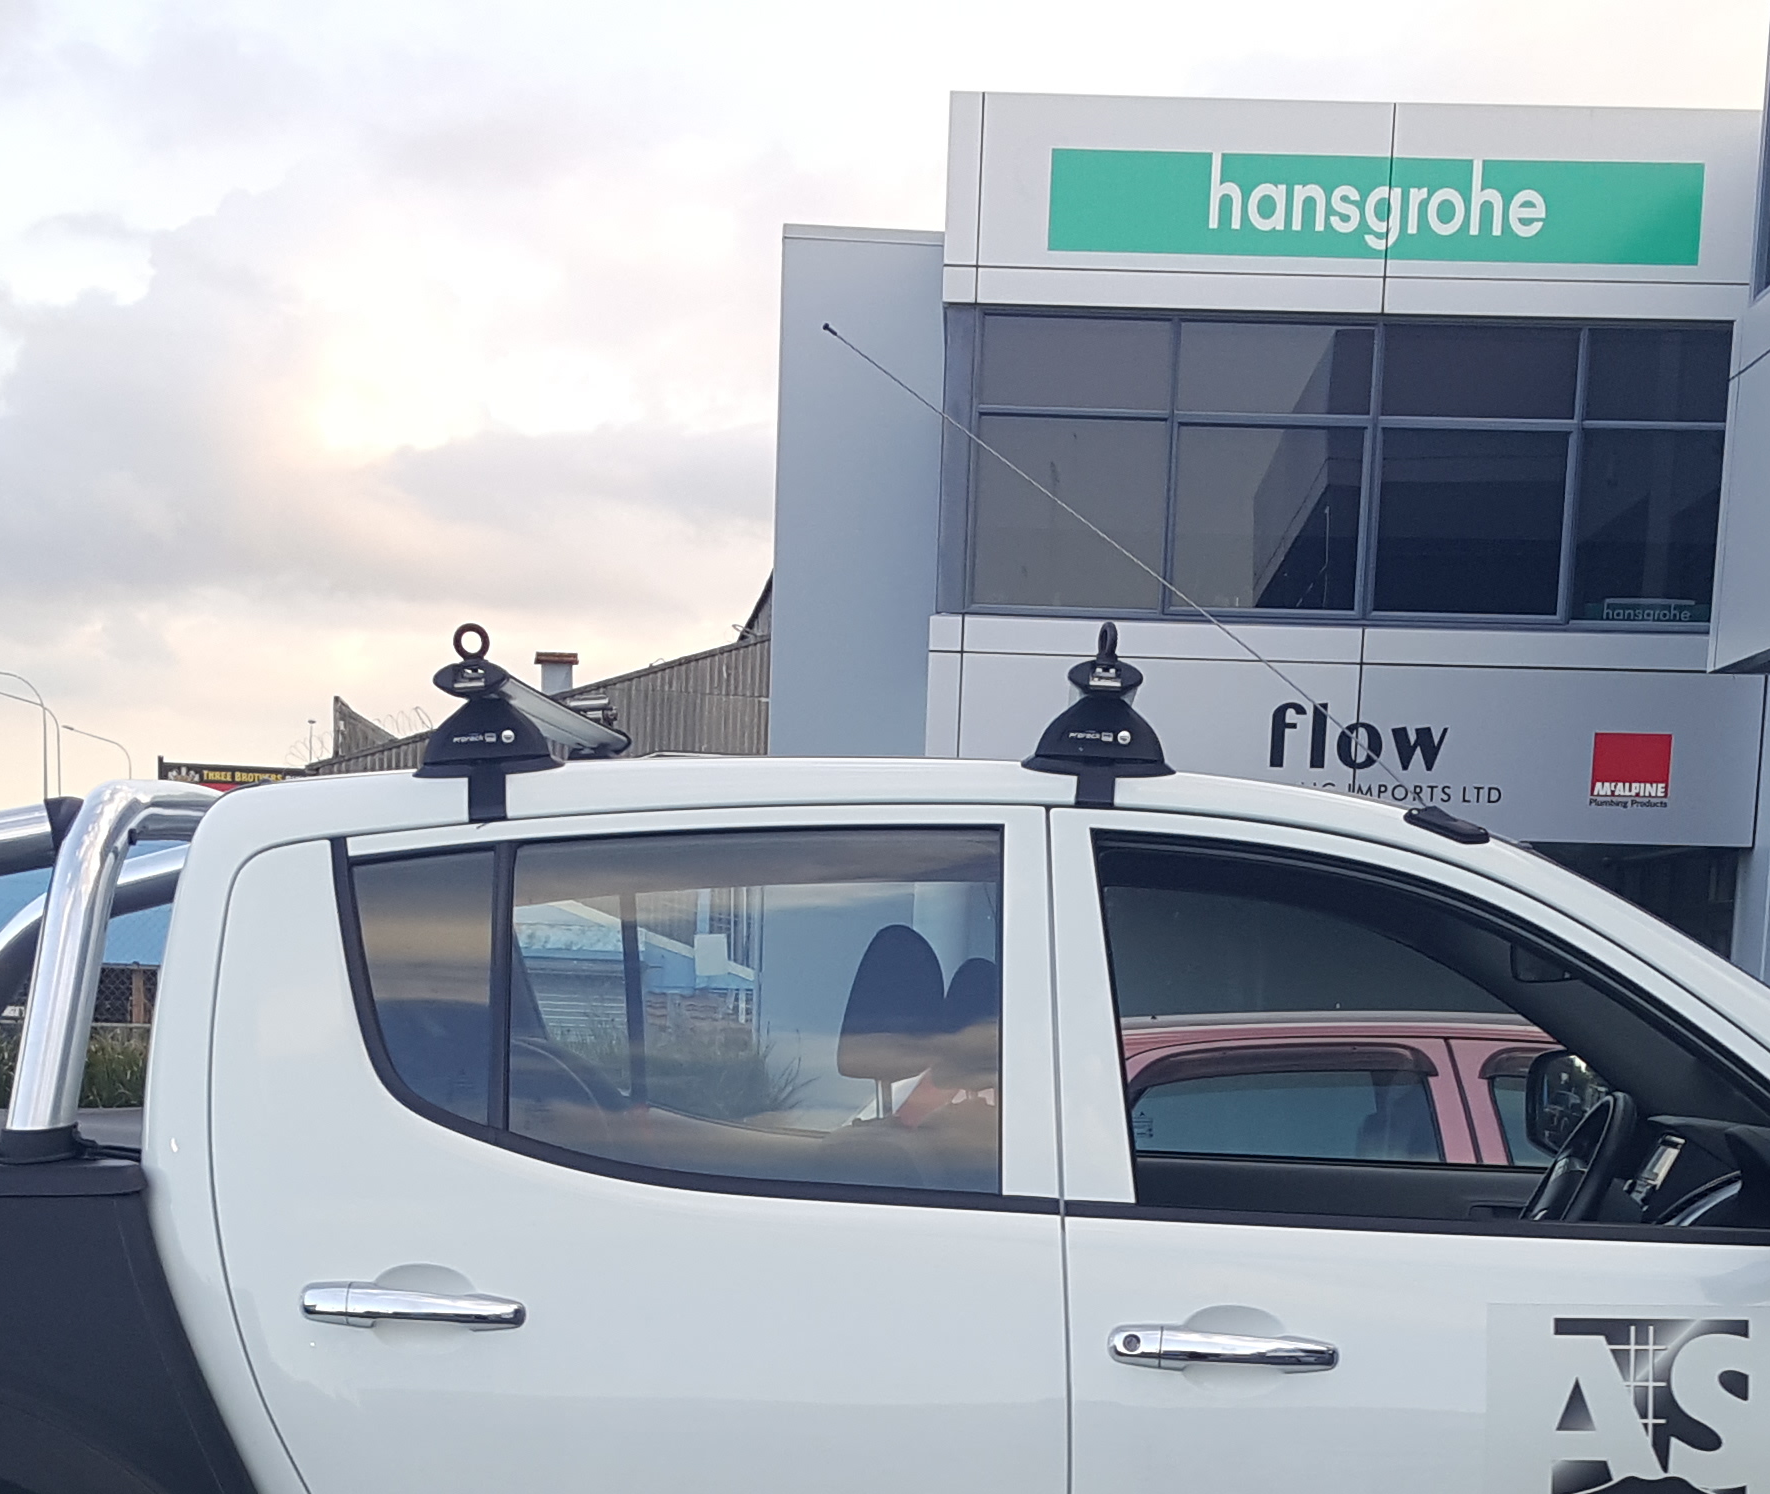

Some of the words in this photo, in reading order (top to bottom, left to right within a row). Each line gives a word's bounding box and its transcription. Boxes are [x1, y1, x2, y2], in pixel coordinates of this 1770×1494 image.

[1207, 153, 1547, 251] hansgrohe
[1269, 702, 1449, 772] flow
[202, 770, 232, 782] THREE
[1462, 786, 1502, 804] LTD
[1589, 798, 1629, 809] Plumbing
[1630, 799, 1668, 808] Products
